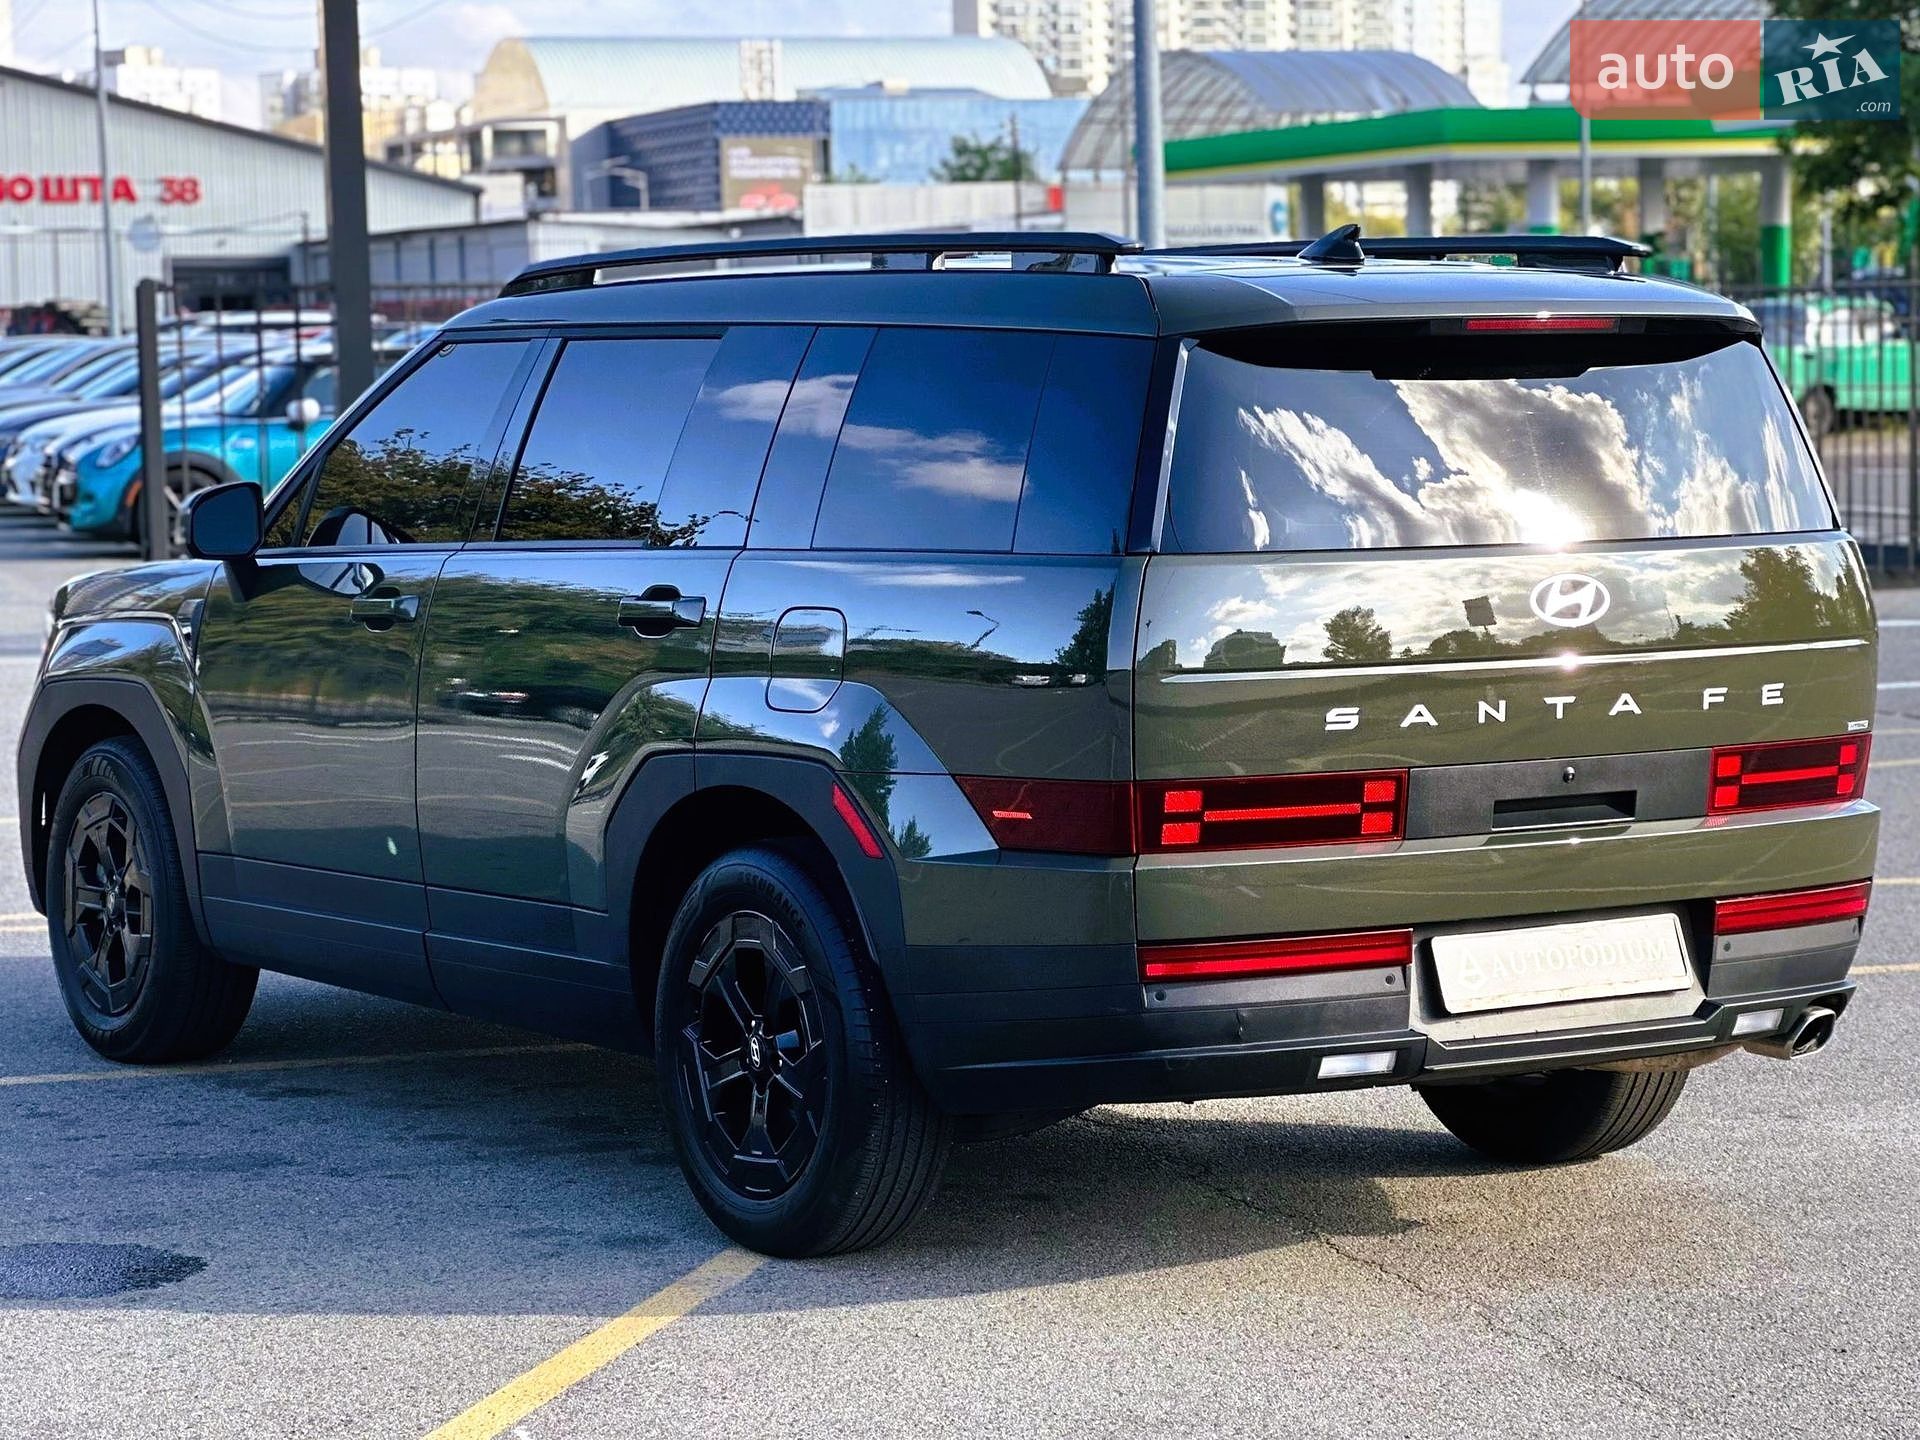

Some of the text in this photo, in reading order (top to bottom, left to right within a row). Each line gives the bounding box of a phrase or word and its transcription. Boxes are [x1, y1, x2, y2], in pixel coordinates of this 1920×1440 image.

[0, 175, 200, 203] ОШТА 38
[1325, 682, 1785, 731] SANTA FE
[1491, 938, 1669, 979] AUTOPODIUM
